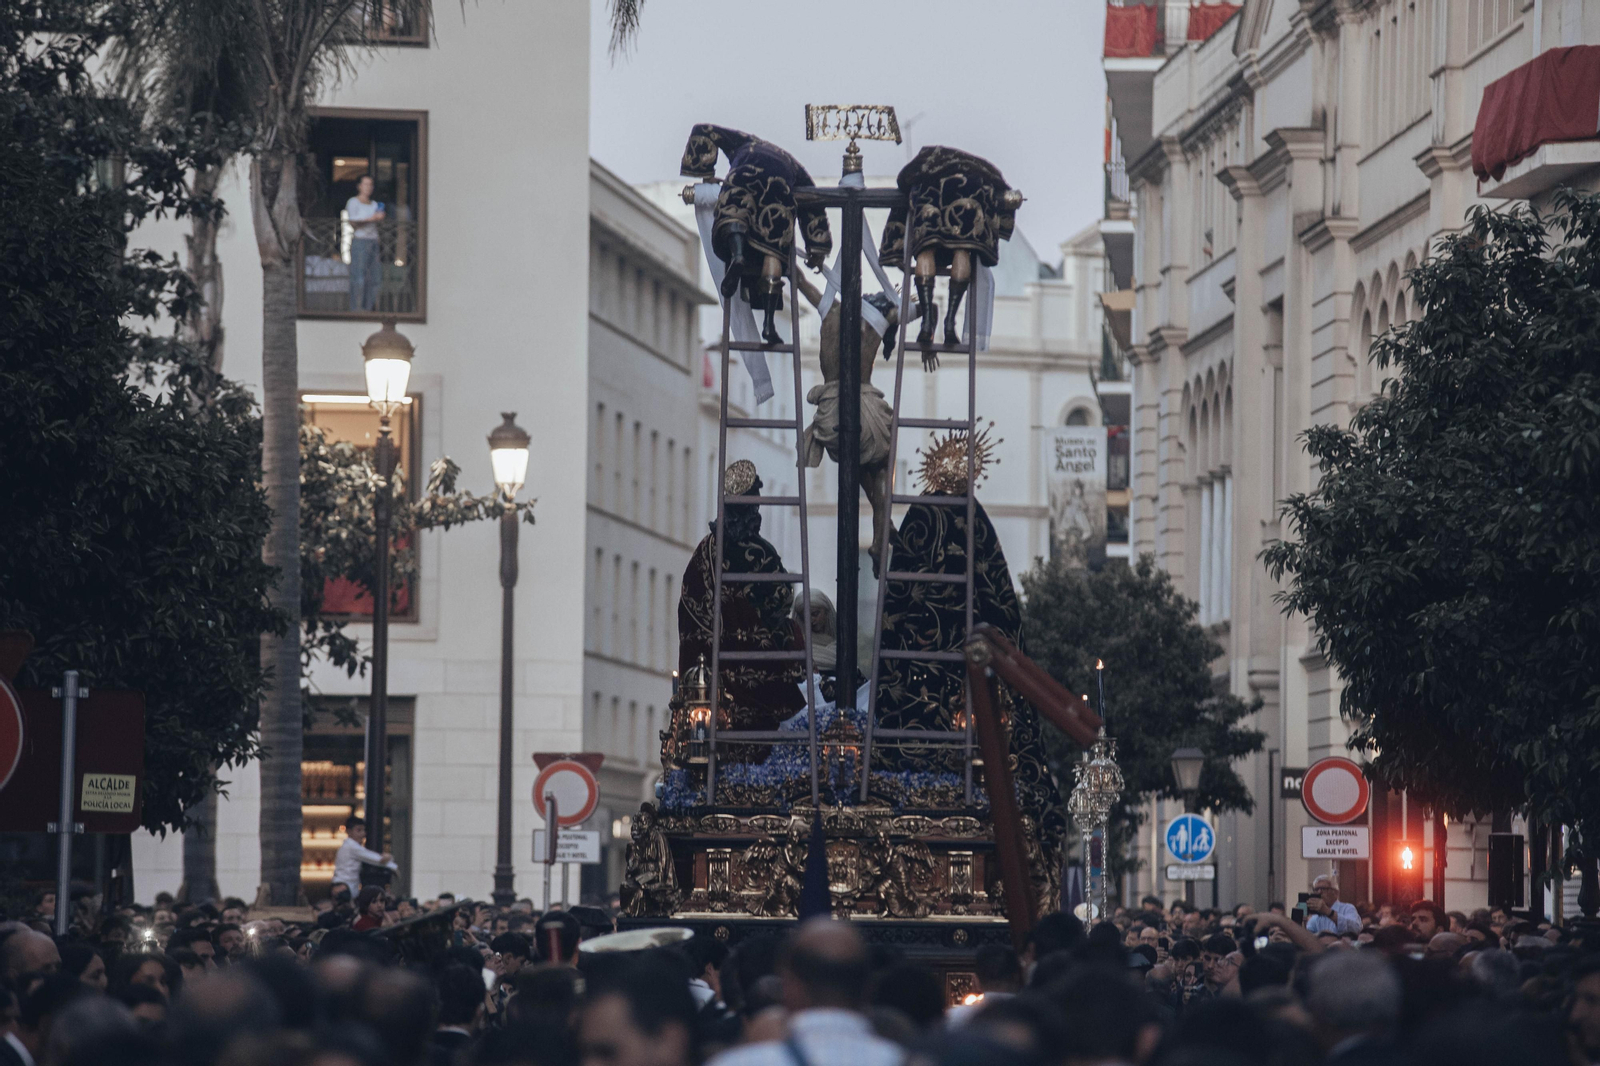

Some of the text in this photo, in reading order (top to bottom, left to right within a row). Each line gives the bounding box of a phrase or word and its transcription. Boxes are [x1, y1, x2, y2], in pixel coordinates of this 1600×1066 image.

[1055, 445, 1097, 458] Santo
[88, 777, 130, 791] ALCALDE
[83, 799, 132, 809] POLICÍA LOCAL
